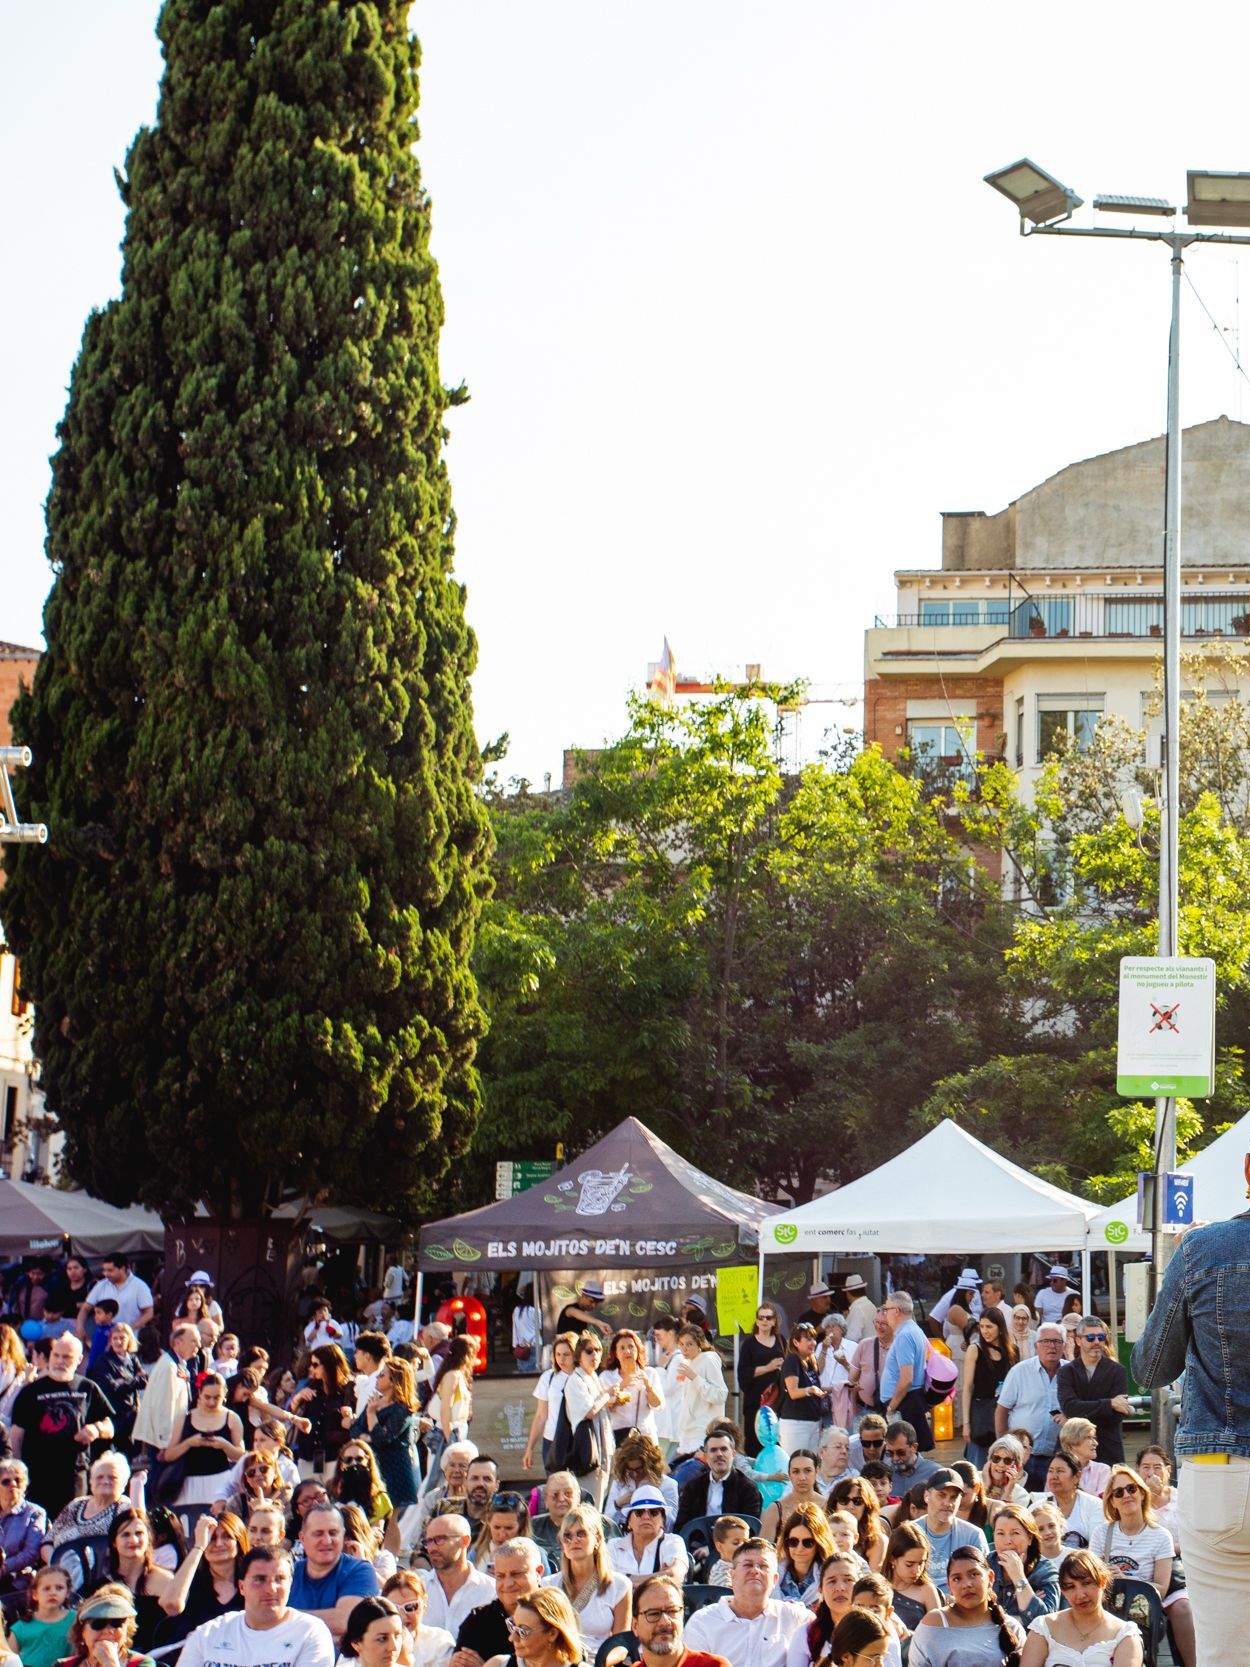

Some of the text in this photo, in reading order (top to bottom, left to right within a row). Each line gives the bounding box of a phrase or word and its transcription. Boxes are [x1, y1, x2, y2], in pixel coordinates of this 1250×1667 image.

[1136, 965, 1164, 973] respecte
[1145, 981, 1169, 989] jugueu
[1175, 981, 1195, 989] pilota
[487, 1238, 677, 1258] ELS MOJITOS DE'N CESC
[603, 1279, 628, 1296] ELS
[631, 1275, 687, 1294] MOJITOS
